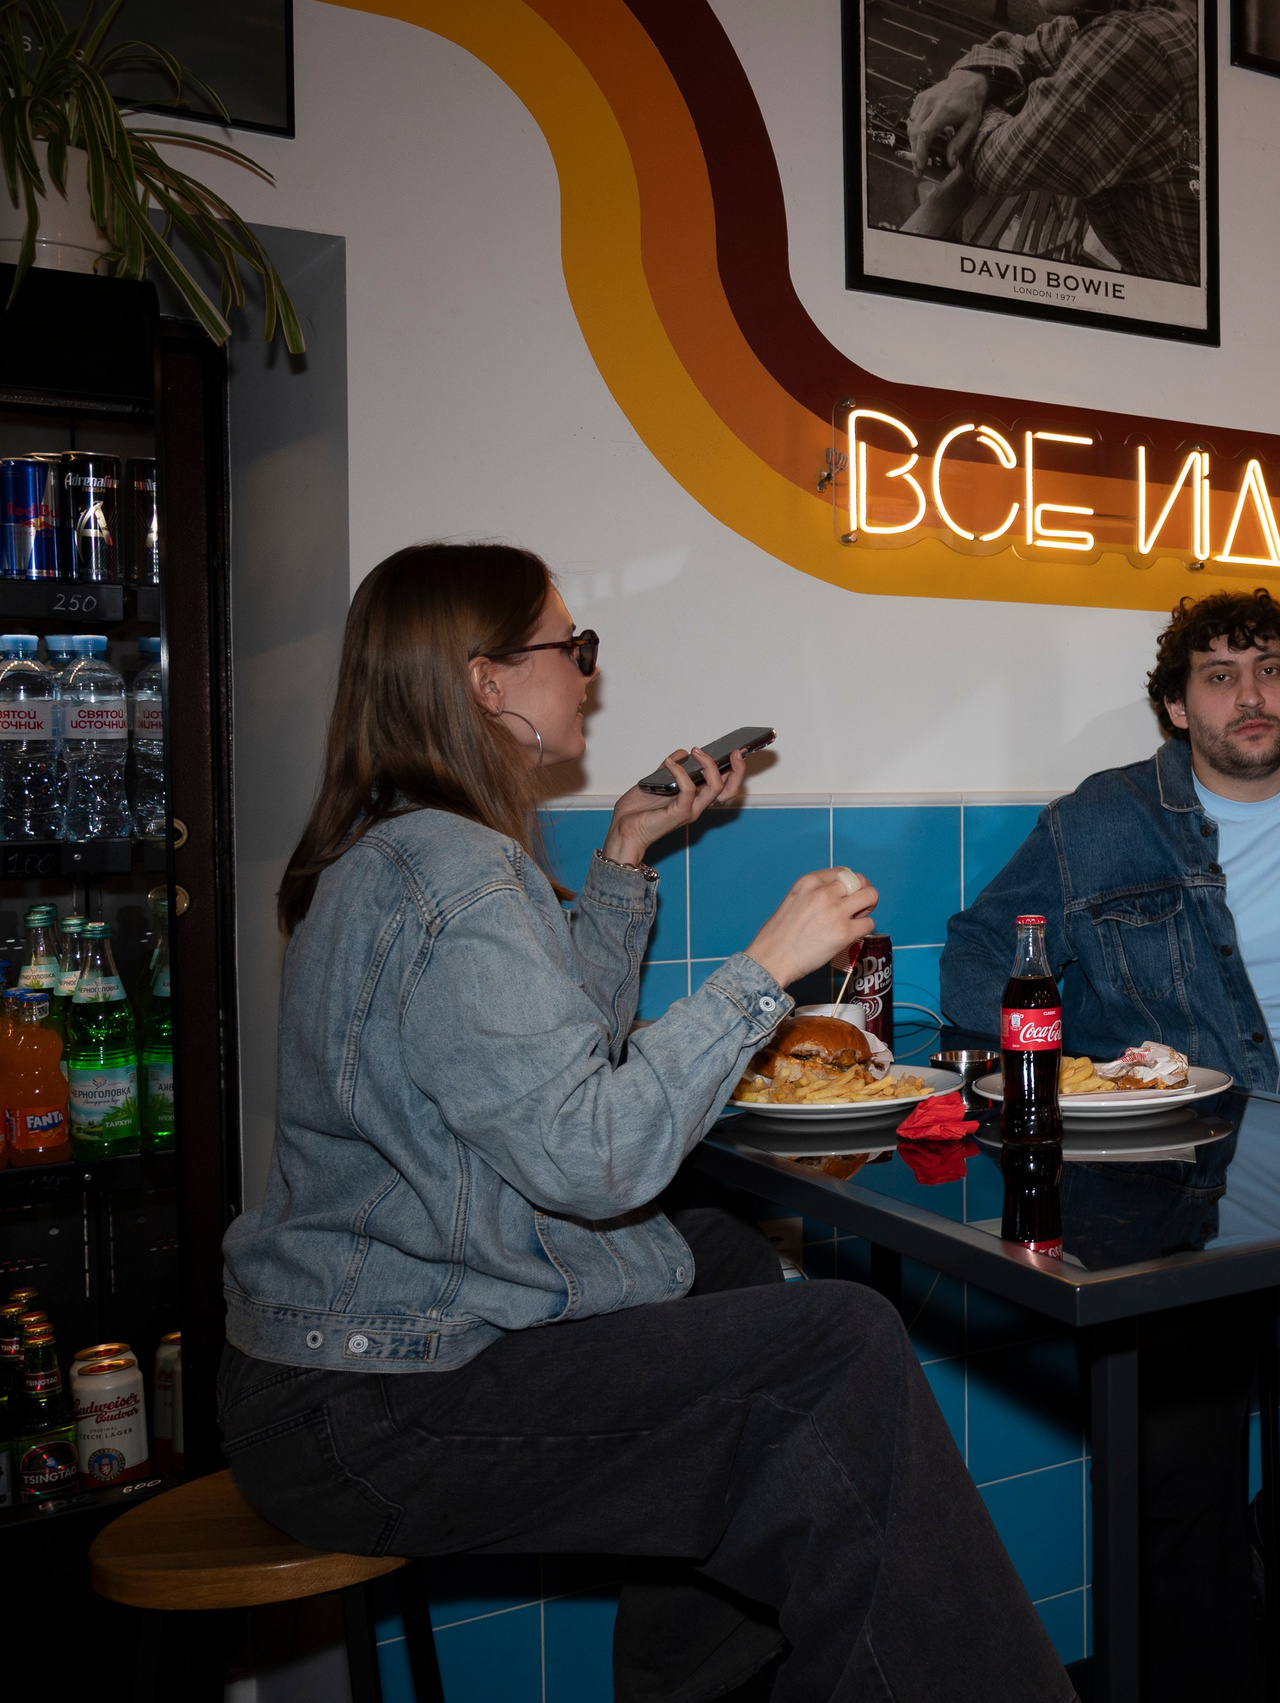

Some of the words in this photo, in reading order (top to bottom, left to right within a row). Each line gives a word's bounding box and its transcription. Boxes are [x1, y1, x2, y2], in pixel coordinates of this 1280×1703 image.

[960, 256, 1036, 284] DAVID
[1046, 271, 1125, 300] BOWIE
[1013, 285, 1052, 298] LONDON
[1055, 293, 1076, 302] 1977
[847, 409, 1095, 551] ВСЕ
[7, 501, 38, 517] Red
[53, 593, 97, 612] 250
[78, 708, 124, 719] СВЯТОЙ
[862, 956, 886, 976] Dr
[71, 1086, 132, 1099] ЧЕРНОГОЛОВКА
[25, 1110, 64, 1129] FANTA
[105, 1118, 133, 1128] ТАРХУН
[26, 1376, 58, 1386] TSINGTAO
[71, 1393, 140, 1417] Budweiser
[95, 1407, 139, 1424] Budvar
[105, 1428, 133, 1439] LAGER
[23, 1466, 78, 1485] TSINGTAO
[122, 1479, 162, 1493] 600
